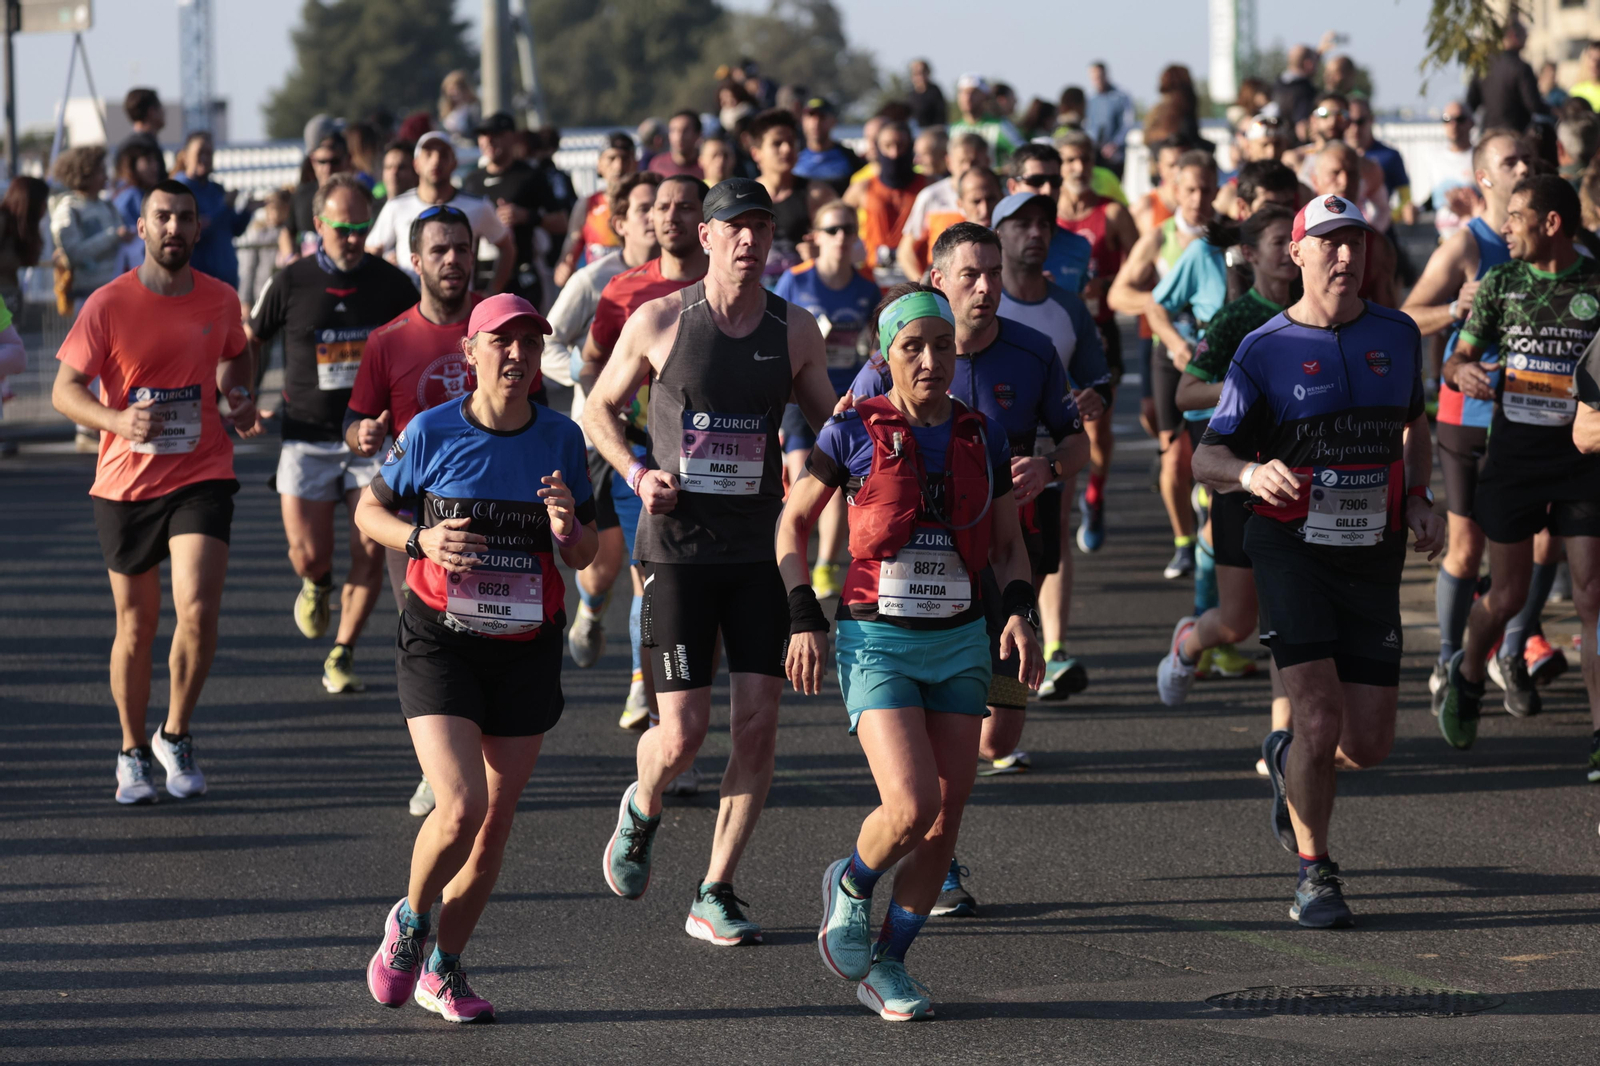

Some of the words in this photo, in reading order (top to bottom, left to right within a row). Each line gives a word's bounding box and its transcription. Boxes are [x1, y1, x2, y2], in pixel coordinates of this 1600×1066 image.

[1528, 358, 1571, 373] ZURICH
[1306, 383, 1335, 392] RENAULT
[152, 388, 193, 402] ZURICH
[713, 417, 760, 430] ZURICH
[711, 442, 739, 456] 7151
[1311, 439, 1390, 462] Bayonnais
[710, 462, 738, 474] MARC
[1340, 472, 1384, 486] ZURICH
[1339, 498, 1368, 511] 7906
[1335, 518, 1368, 528] GILLES
[484, 533, 533, 546] onnais
[915, 533, 954, 547] ZURIC
[481, 554, 532, 569] ZURICH
[913, 561, 946, 576] 8872
[478, 582, 510, 597] 6628
[909, 583, 946, 596] HAFIDA
[477, 603, 512, 616] EMILIE
[663, 652, 673, 681] FUSION
